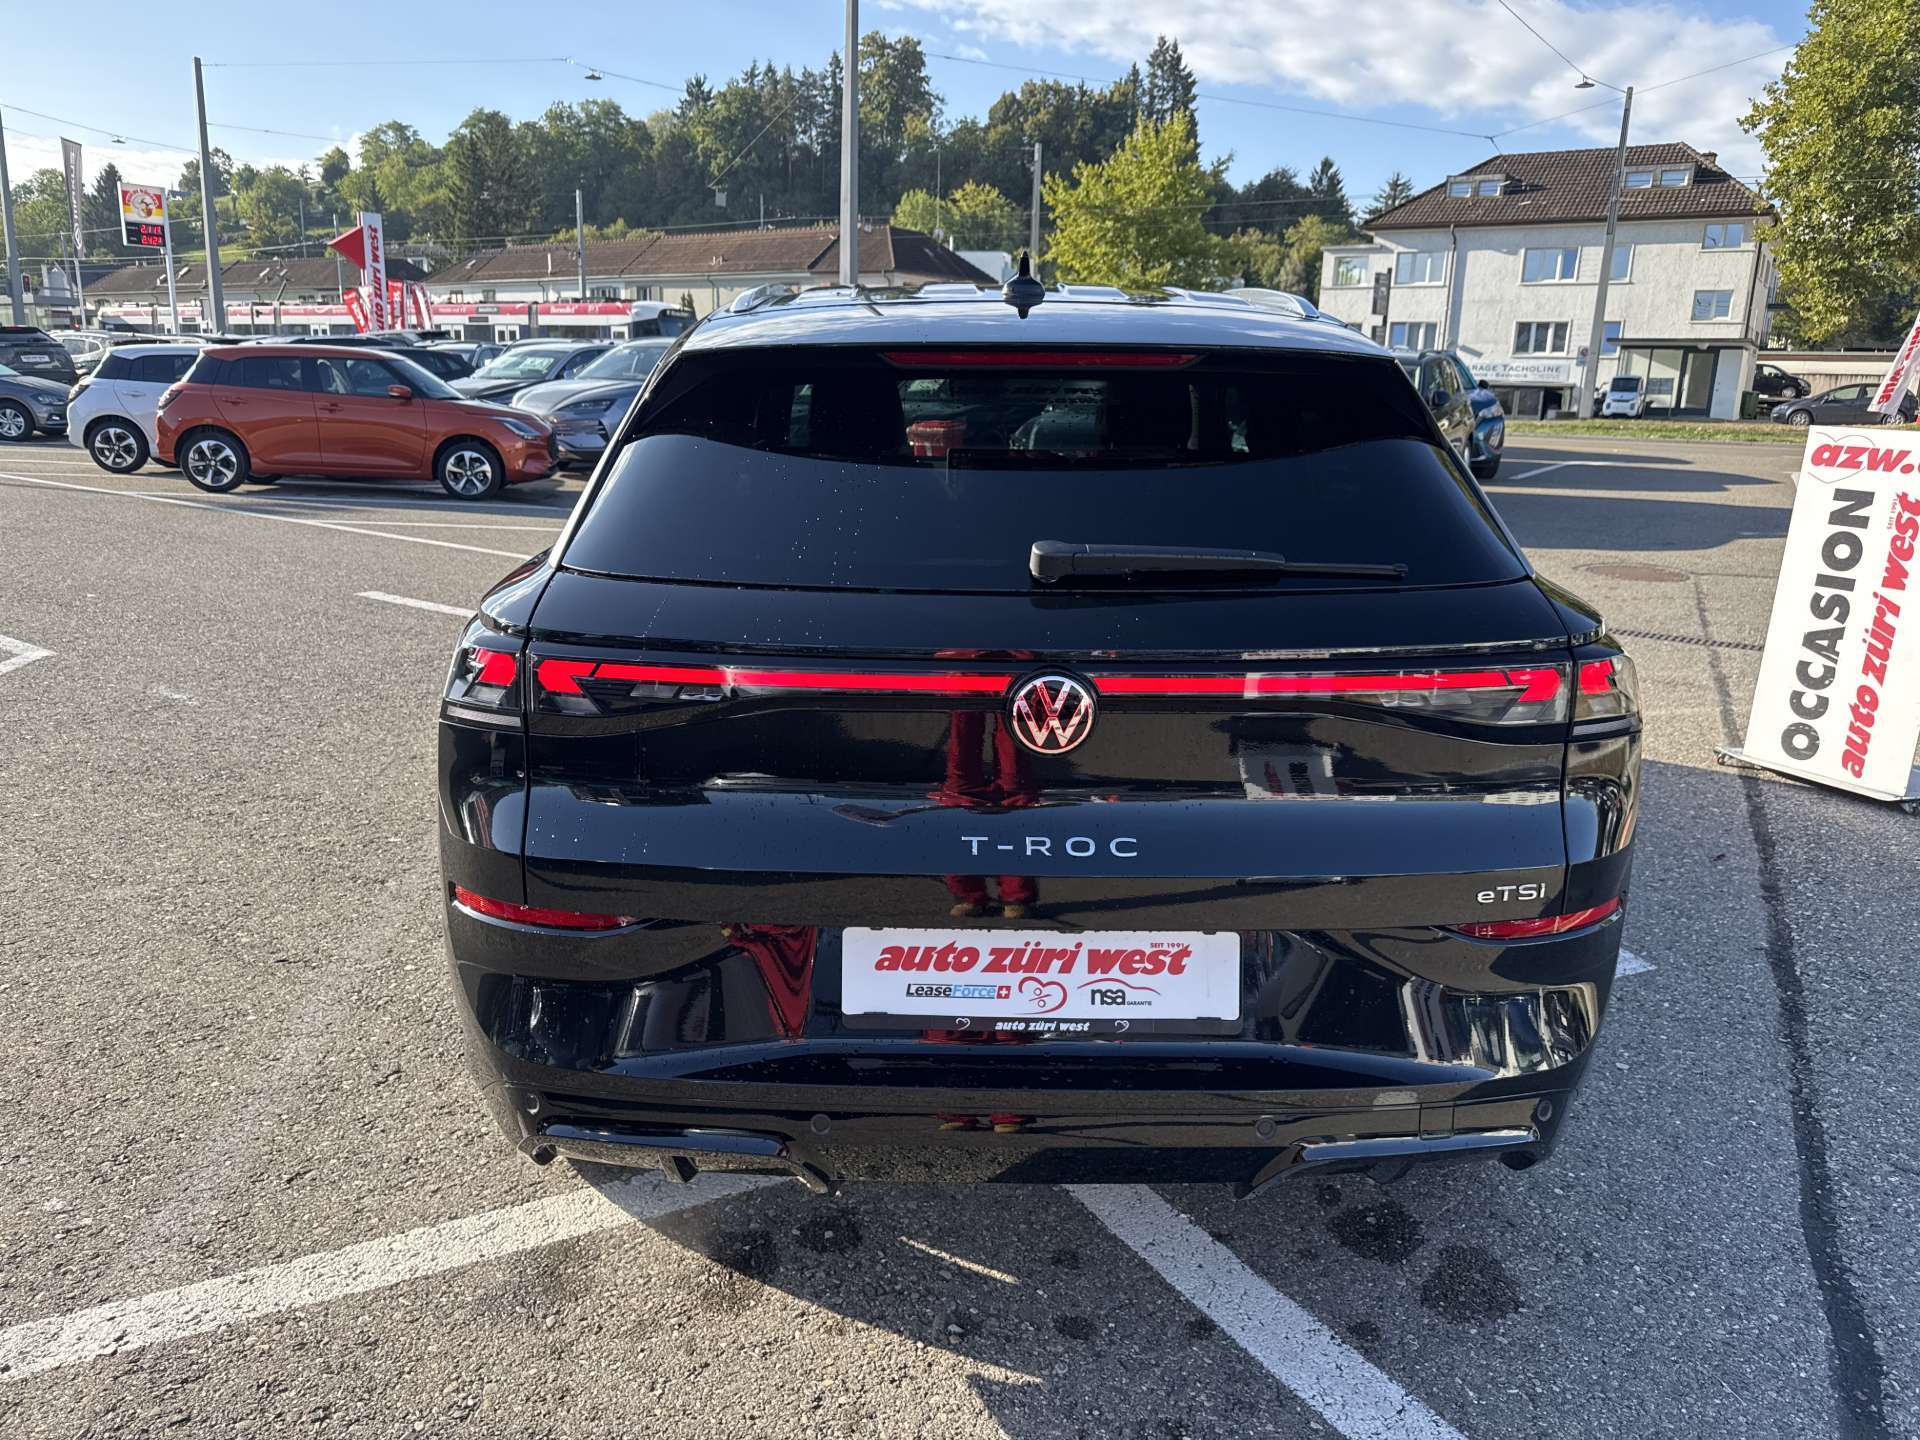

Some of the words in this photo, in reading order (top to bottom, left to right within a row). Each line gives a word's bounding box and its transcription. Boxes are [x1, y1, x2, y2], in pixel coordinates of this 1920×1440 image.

[367, 224, 380, 265] west
[1811, 443, 1920, 475] azw.
[1881, 491, 1920, 592] west
[1781, 488, 1876, 761] OCCASION
[1861, 591, 1902, 688] züri
[1841, 684, 1880, 779] auto
[961, 836, 1138, 858] T-ROC
[874, 940, 981, 973] auto
[981, 940, 1083, 974] züri
[1087, 943, 1193, 976] west
[906, 983, 997, 1000] LeaseForce
[1090, 988, 1126, 1006] nsa
[994, 1021, 1026, 1032] auto
[1027, 1020, 1057, 1032] züri
[1058, 1021, 1091, 1032] west
